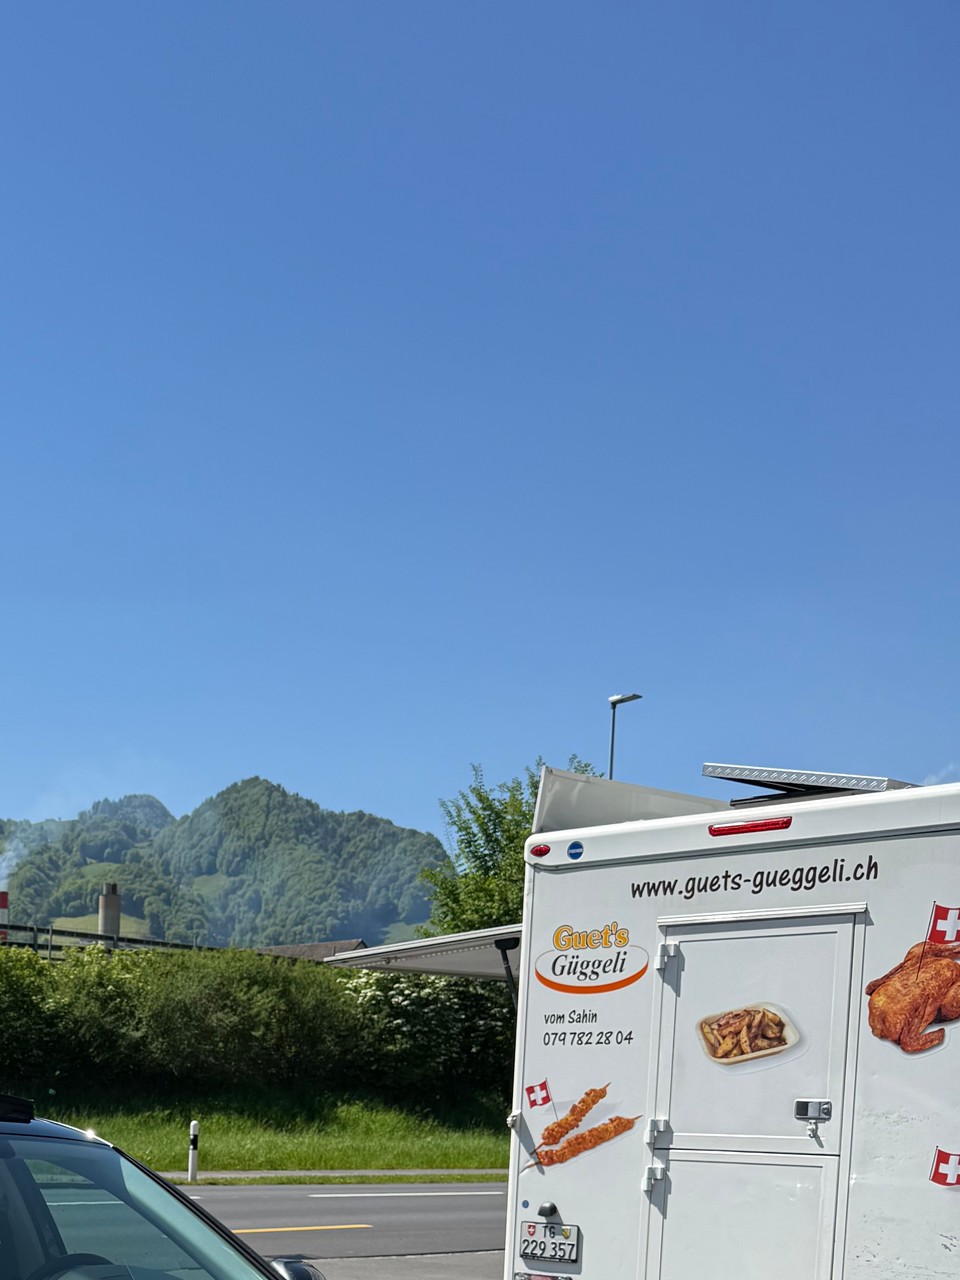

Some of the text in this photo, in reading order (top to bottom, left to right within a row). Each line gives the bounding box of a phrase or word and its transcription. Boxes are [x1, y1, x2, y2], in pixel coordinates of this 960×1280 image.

[631, 855, 879, 900] www.guets-gueggeli.ch
[553, 921, 630, 951] Guet's
[551, 951, 628, 981] Güggeli
[544, 1009, 598, 1025] vom Sahin
[543, 1030, 634, 1046] 079 782 28 04
[542, 1225, 556, 1239] TG
[522, 1239, 576, 1260] 229 357
